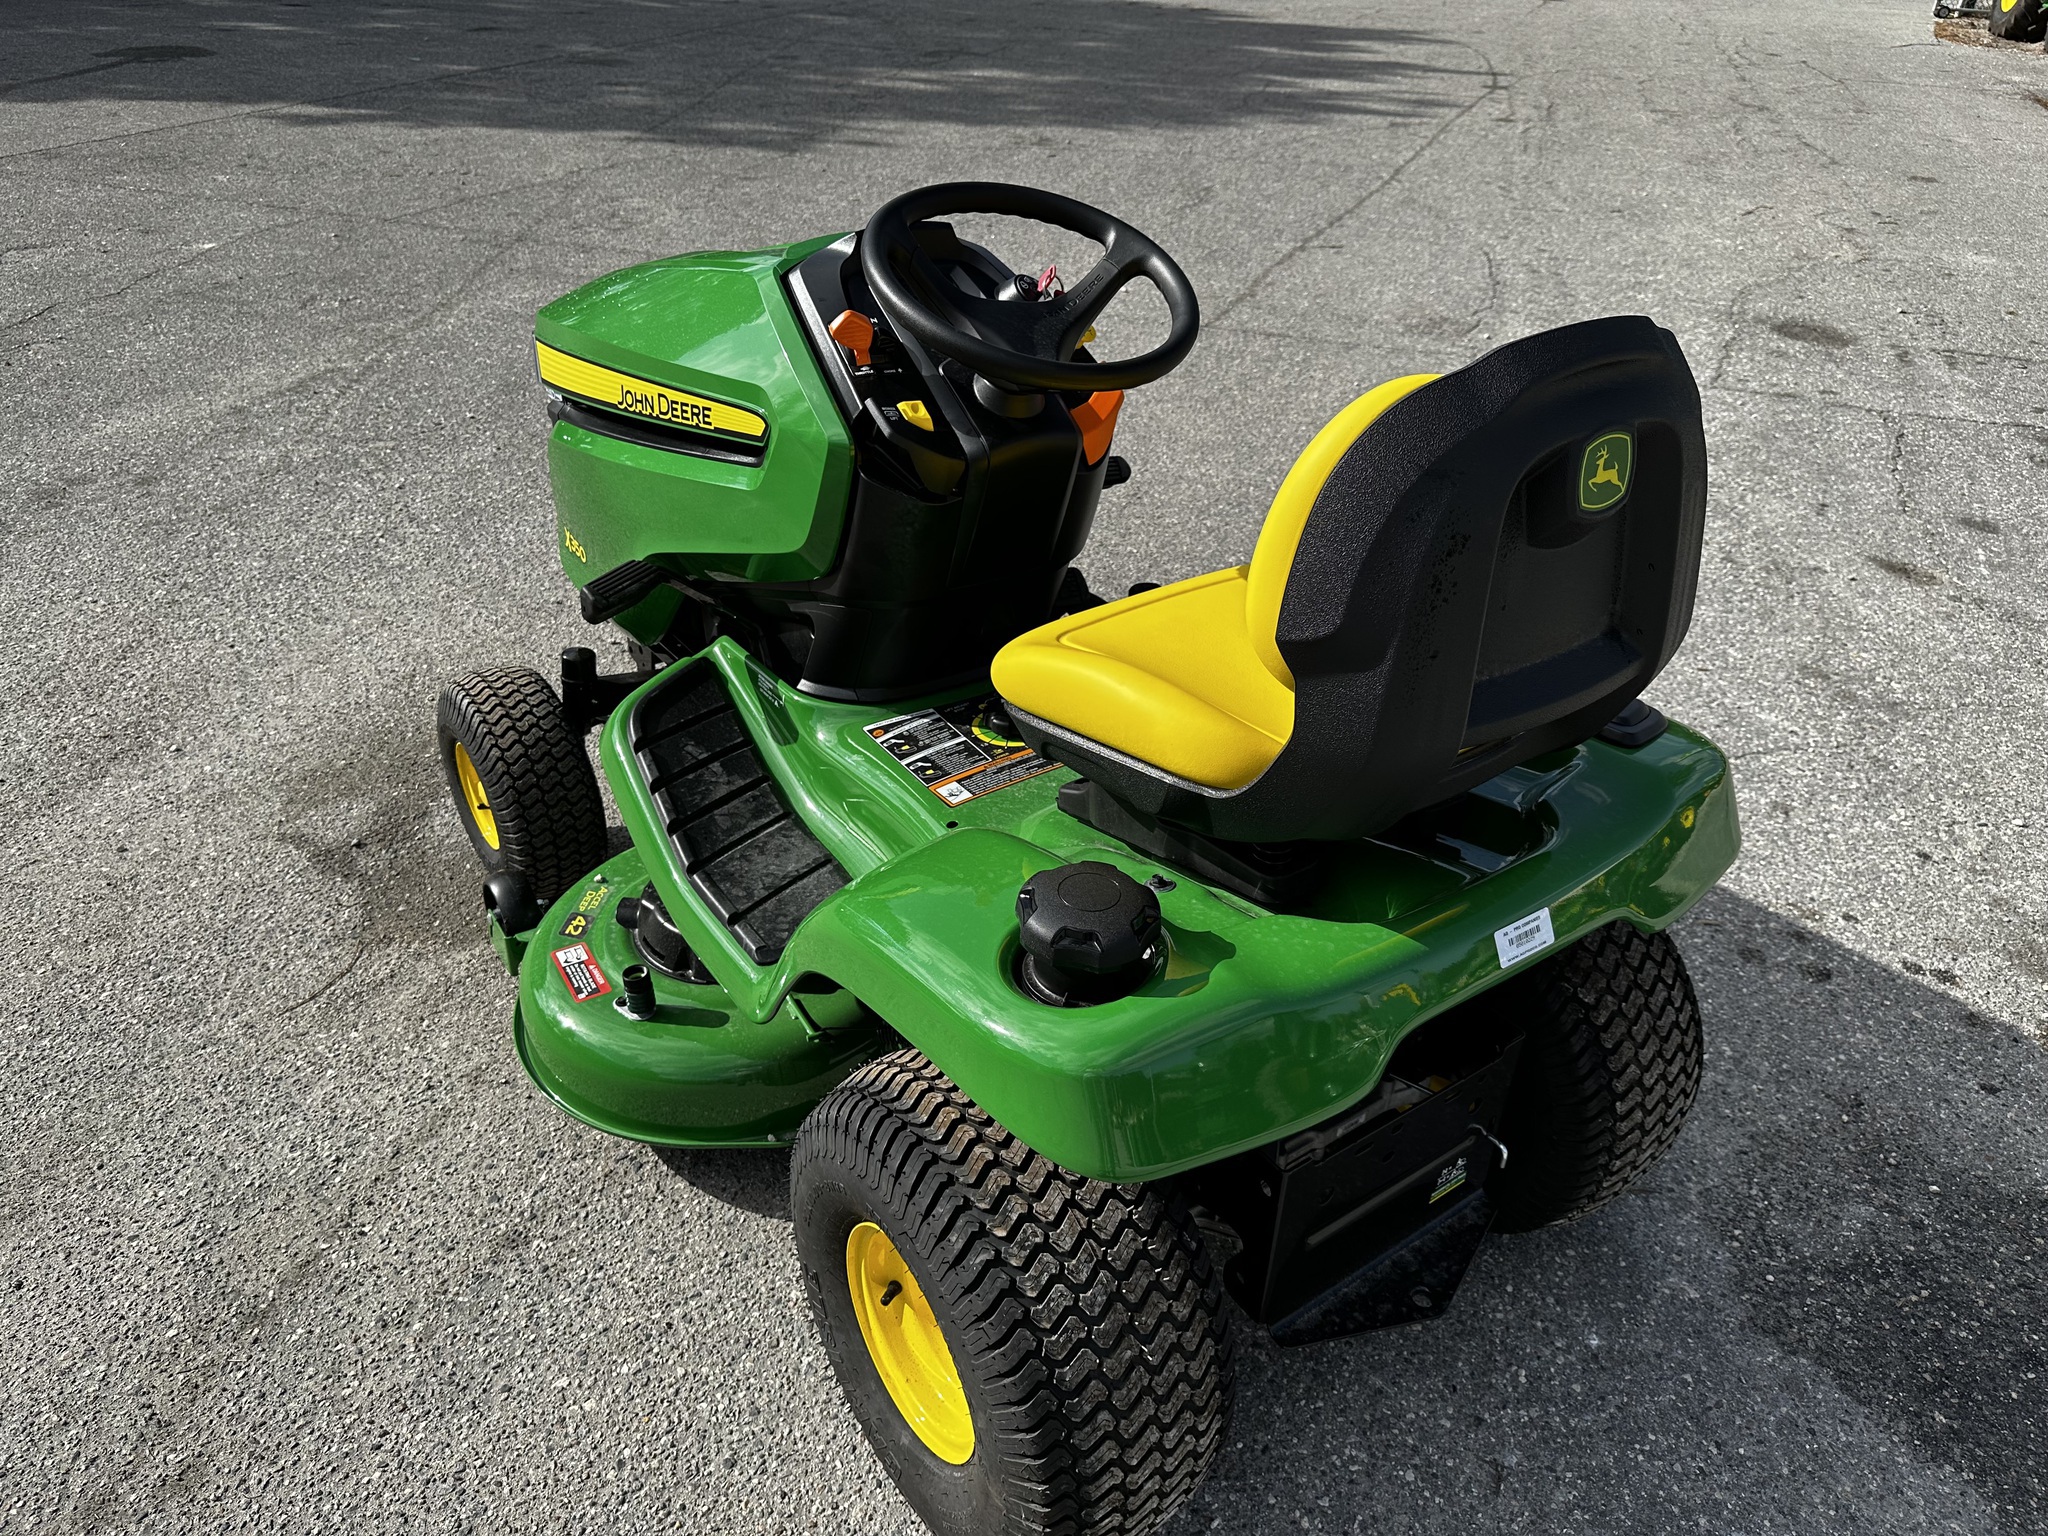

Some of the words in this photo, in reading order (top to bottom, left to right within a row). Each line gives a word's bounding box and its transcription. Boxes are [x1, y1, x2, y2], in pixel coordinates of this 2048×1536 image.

[617, 384, 655, 416] JOHN
[657, 392, 714, 429] DEERE
[579, 890, 597, 911] DEEP
[588, 886, 608, 910] ACCEL
[565, 915, 586, 936] 42
